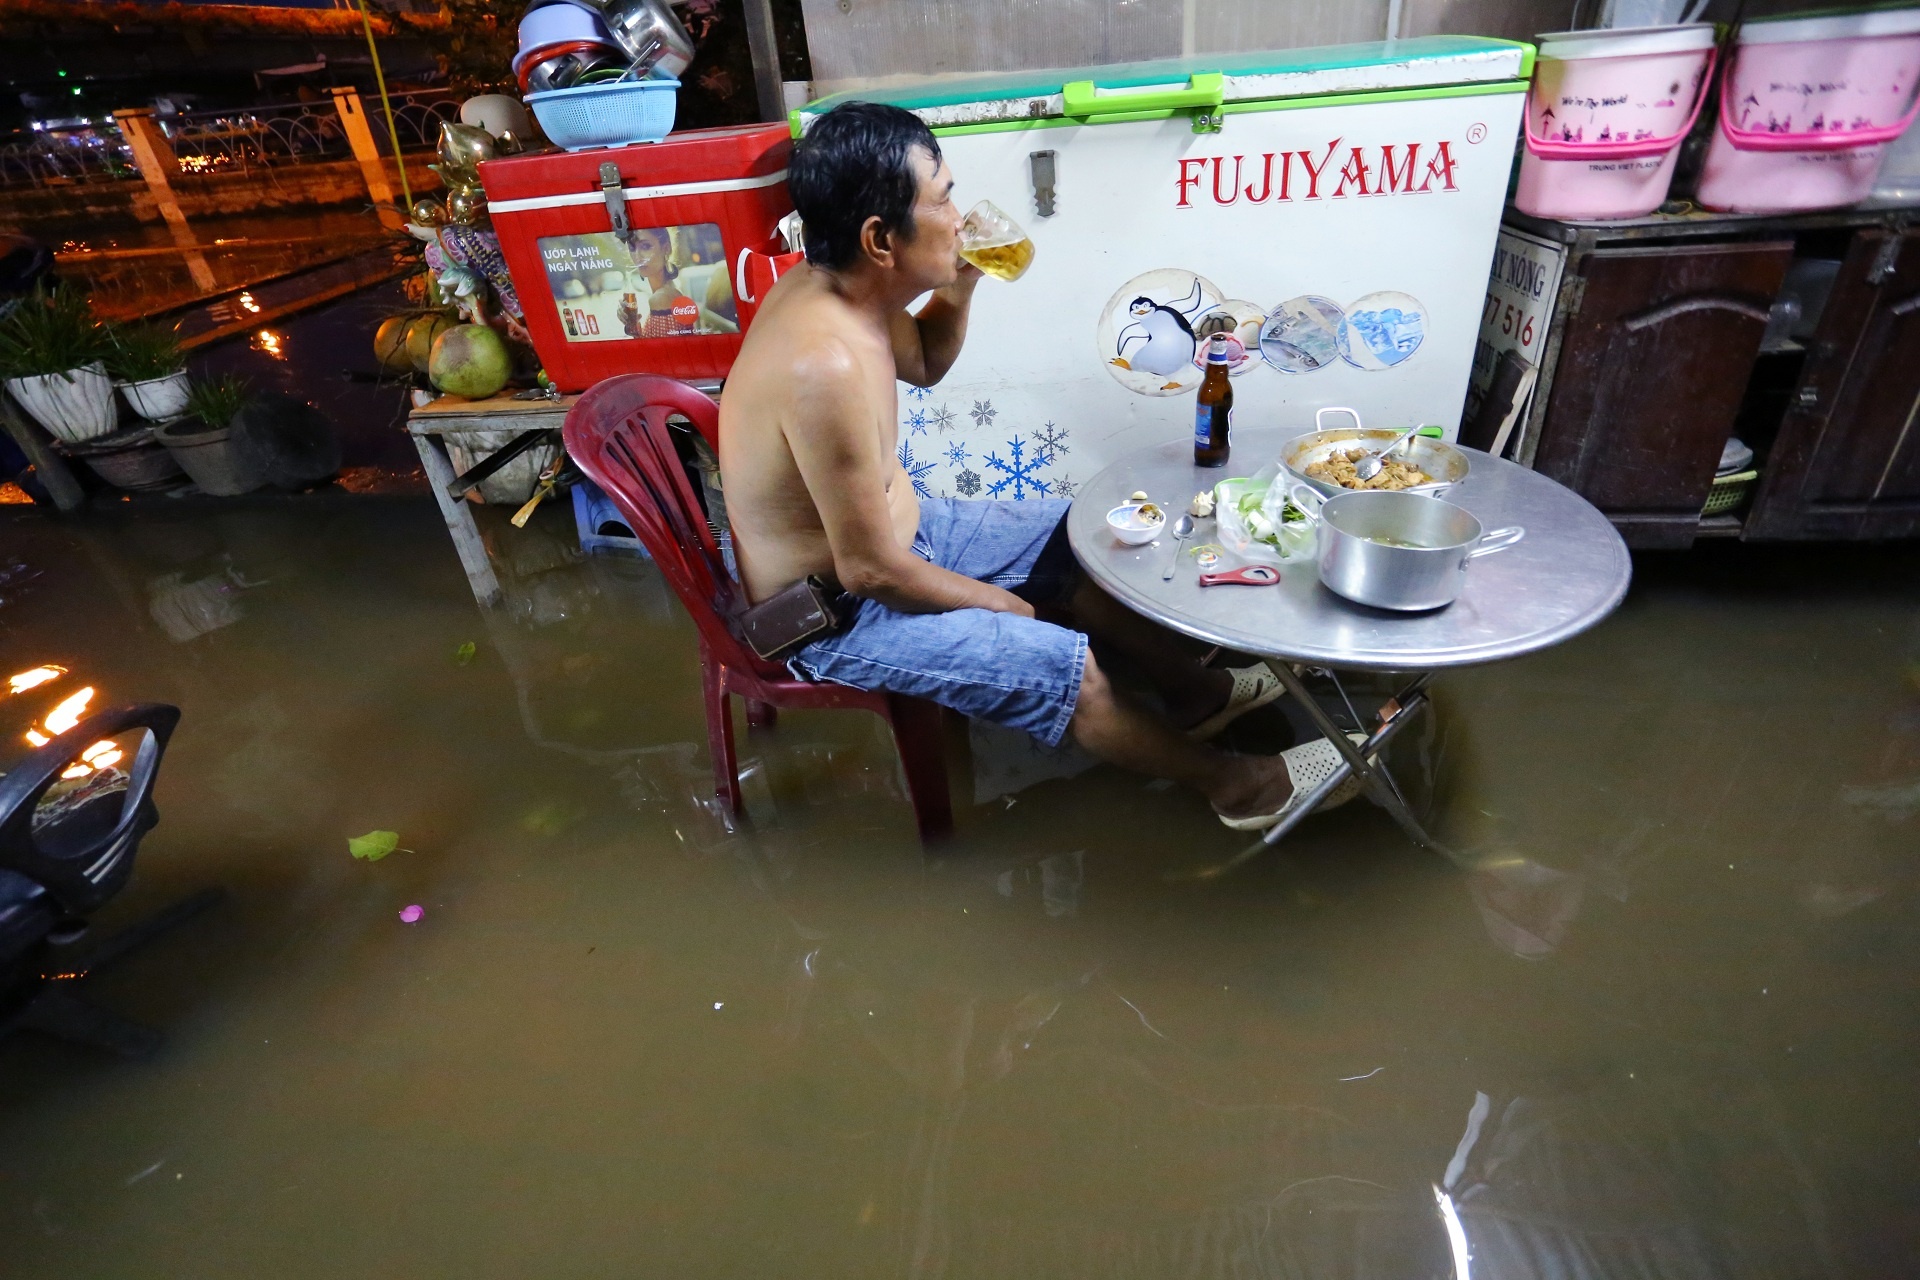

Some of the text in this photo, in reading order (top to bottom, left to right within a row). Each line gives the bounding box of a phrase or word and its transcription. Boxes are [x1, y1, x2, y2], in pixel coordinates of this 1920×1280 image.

[1175, 136, 1460, 209] FUJIYAMA
[548, 260, 578, 273] NGÀY
[569, 246, 600, 260] LẠNH
[1506, 247, 1546, 298] NÓNG
[1502, 304, 1535, 346] 516
